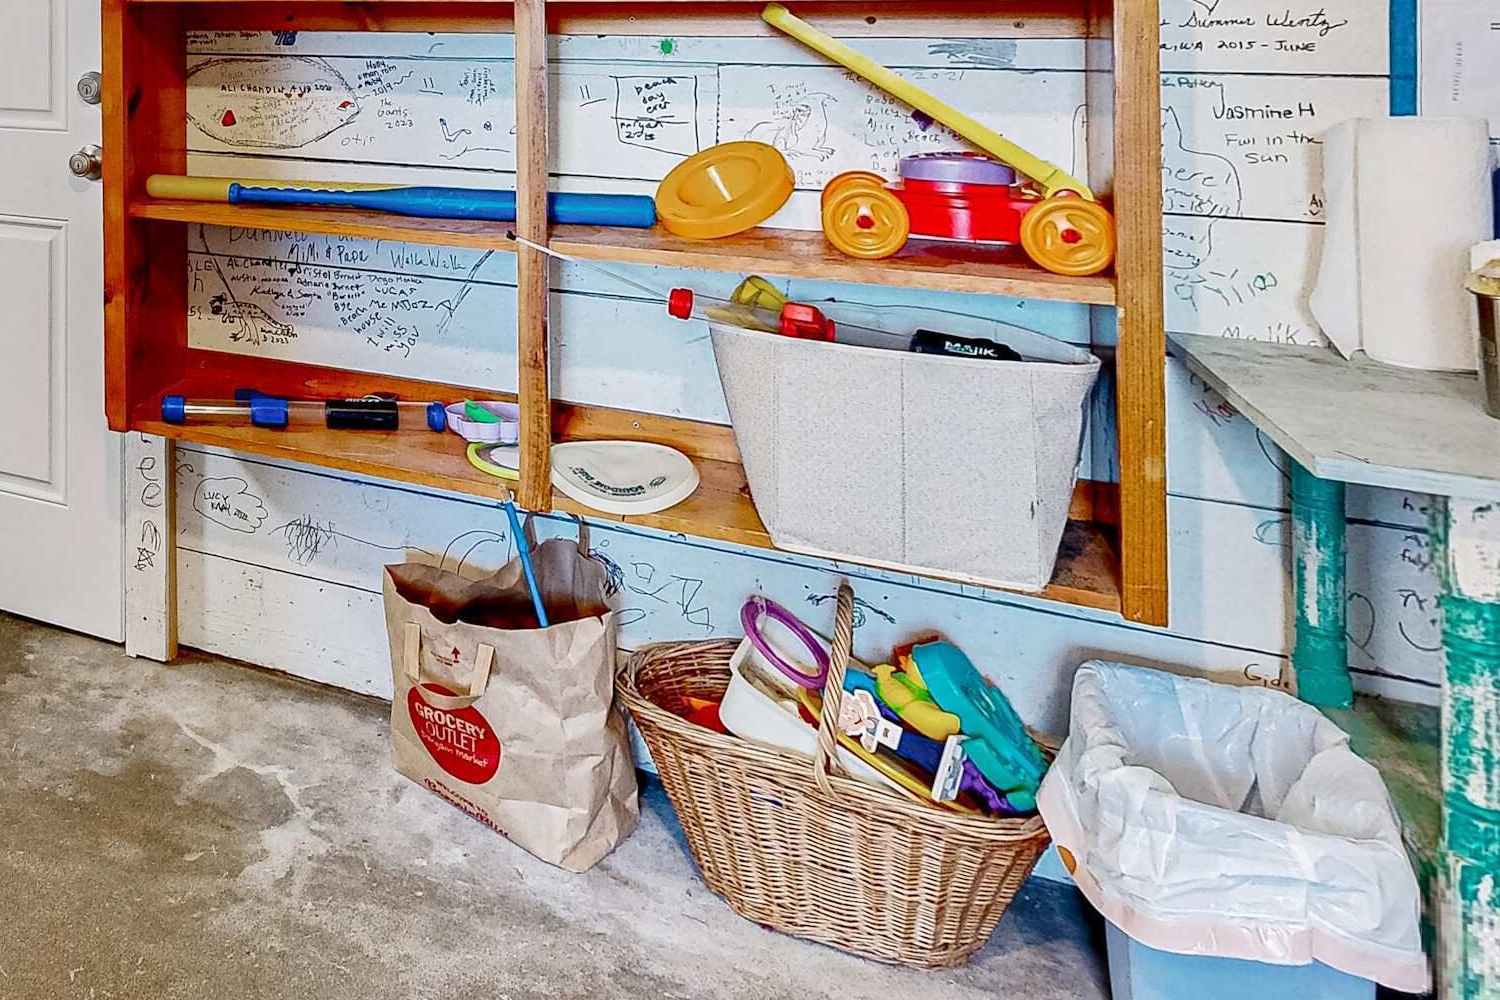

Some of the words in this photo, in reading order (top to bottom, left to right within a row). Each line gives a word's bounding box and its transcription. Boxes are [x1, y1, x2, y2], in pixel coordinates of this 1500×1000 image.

[1217, 39, 1256, 51] 2015
[1212, 103, 1296, 121] Jasmine
[1299, 102, 1316, 118] H
[414, 701, 485, 740] GROCERY
[425, 721, 478, 753] OUTLET
[455, 747, 490, 768] market
